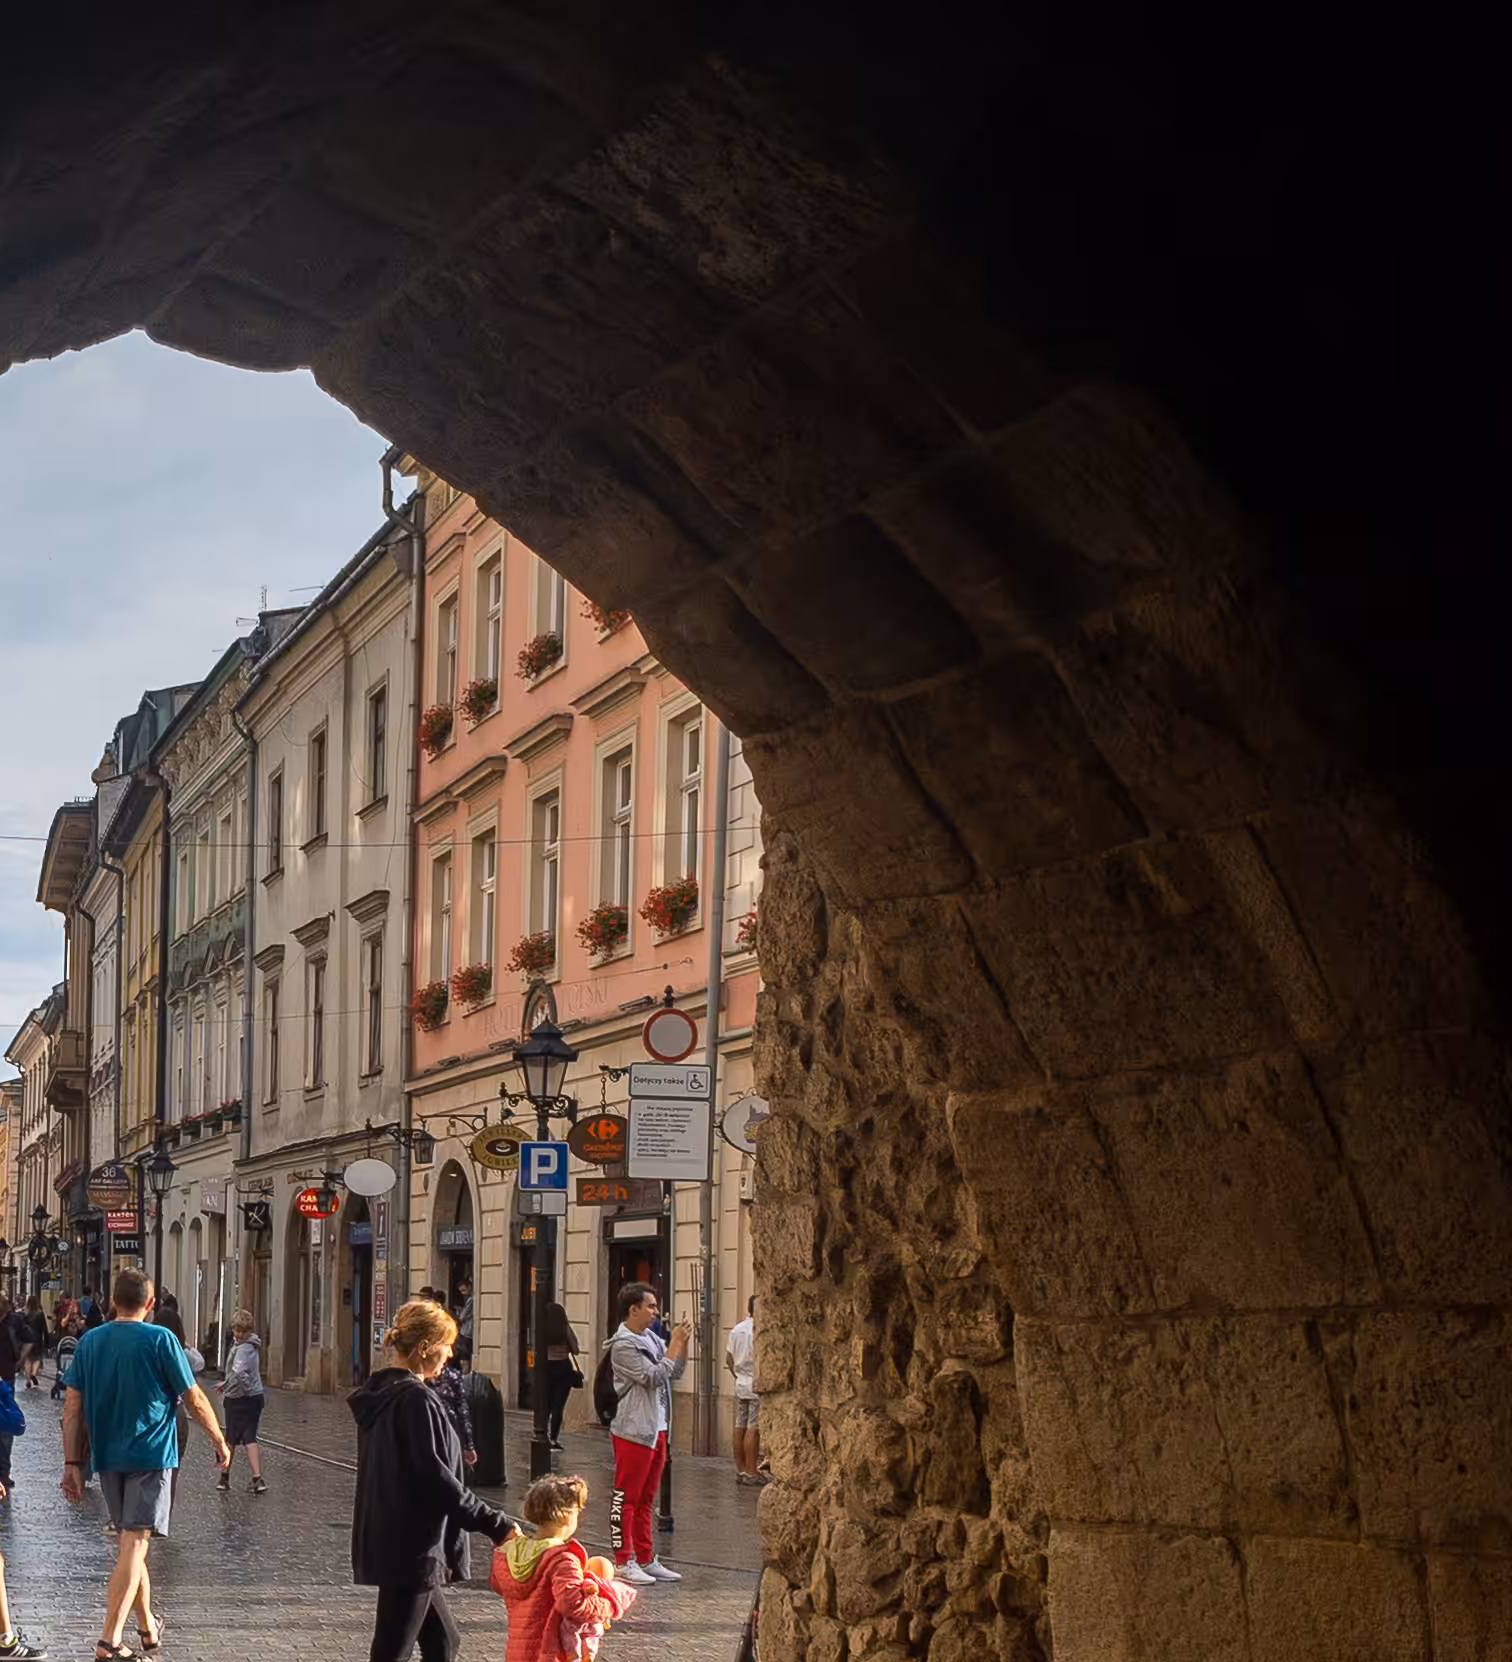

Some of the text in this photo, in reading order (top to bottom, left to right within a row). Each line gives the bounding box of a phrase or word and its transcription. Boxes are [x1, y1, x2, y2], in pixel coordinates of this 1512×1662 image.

[101, 1166, 116, 1178] 36
[530, 1147, 558, 1185] P
[583, 1183, 610, 1201] 24
[610, 1489, 625, 1549] NIKE AIR
